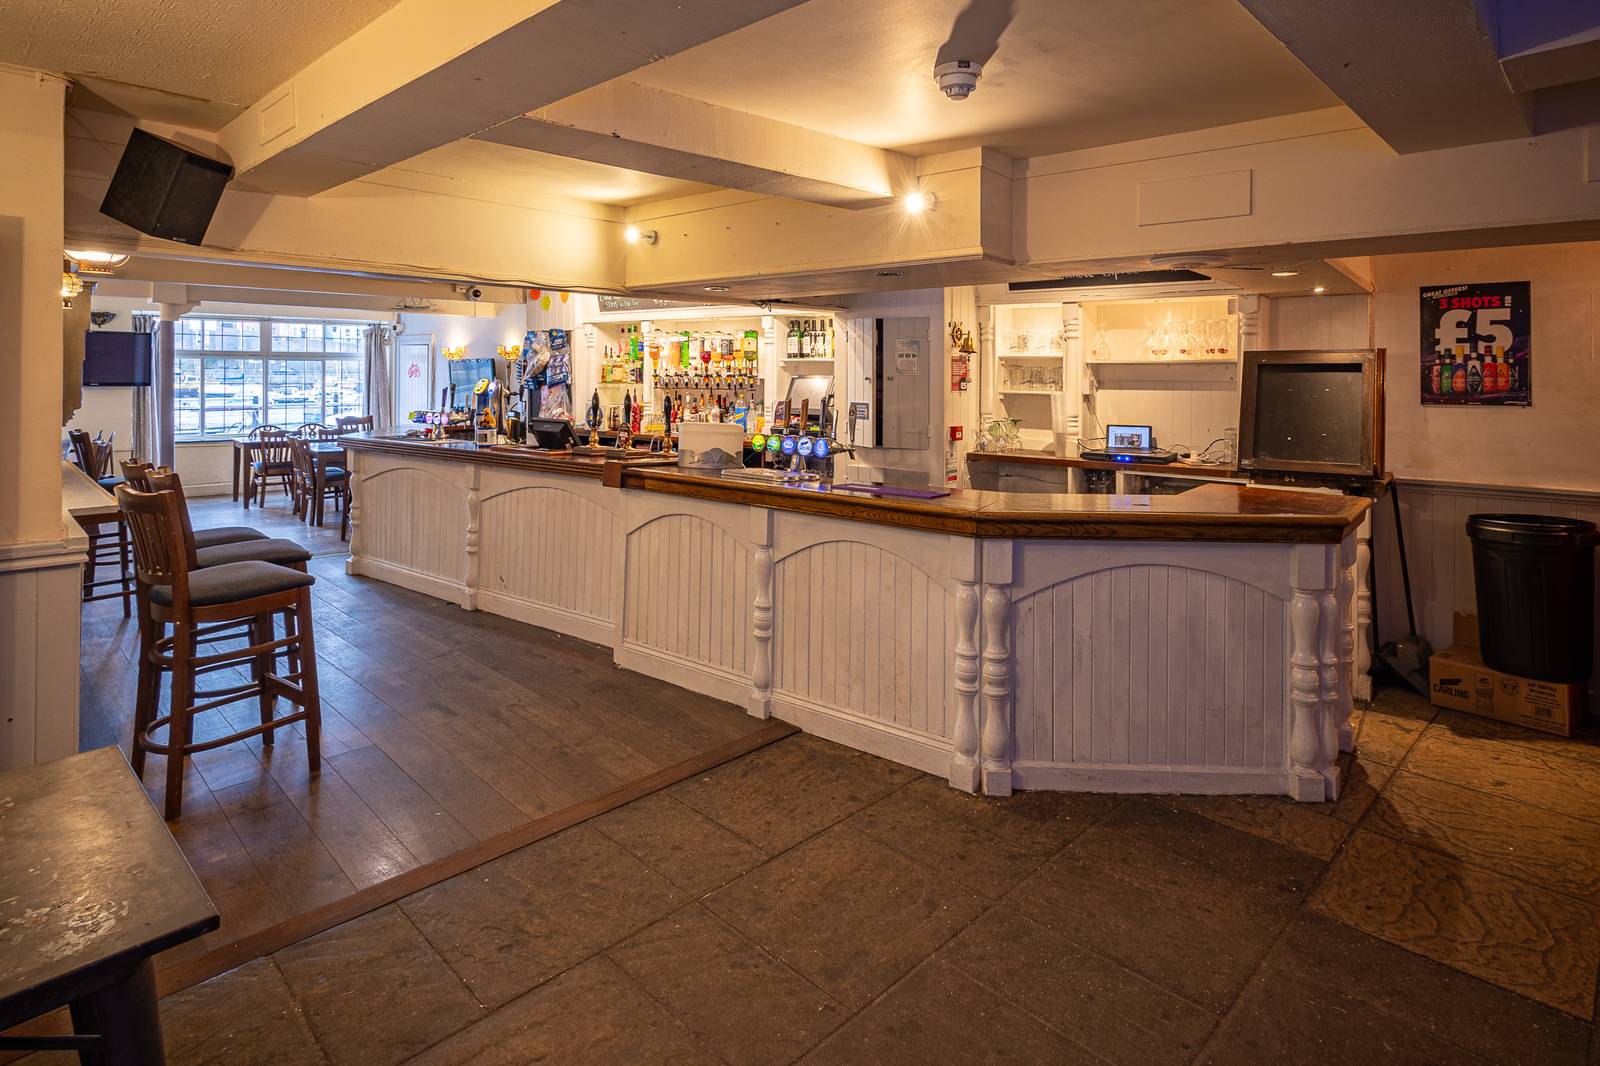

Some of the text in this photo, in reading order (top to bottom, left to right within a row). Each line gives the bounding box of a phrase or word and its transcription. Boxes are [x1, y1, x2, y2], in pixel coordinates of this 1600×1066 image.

[1439, 298, 1449, 309] 3
[1451, 296, 1501, 309] SHOTS
[1435, 308, 1513, 355] £5
[1433, 683, 1470, 699] CARLING
